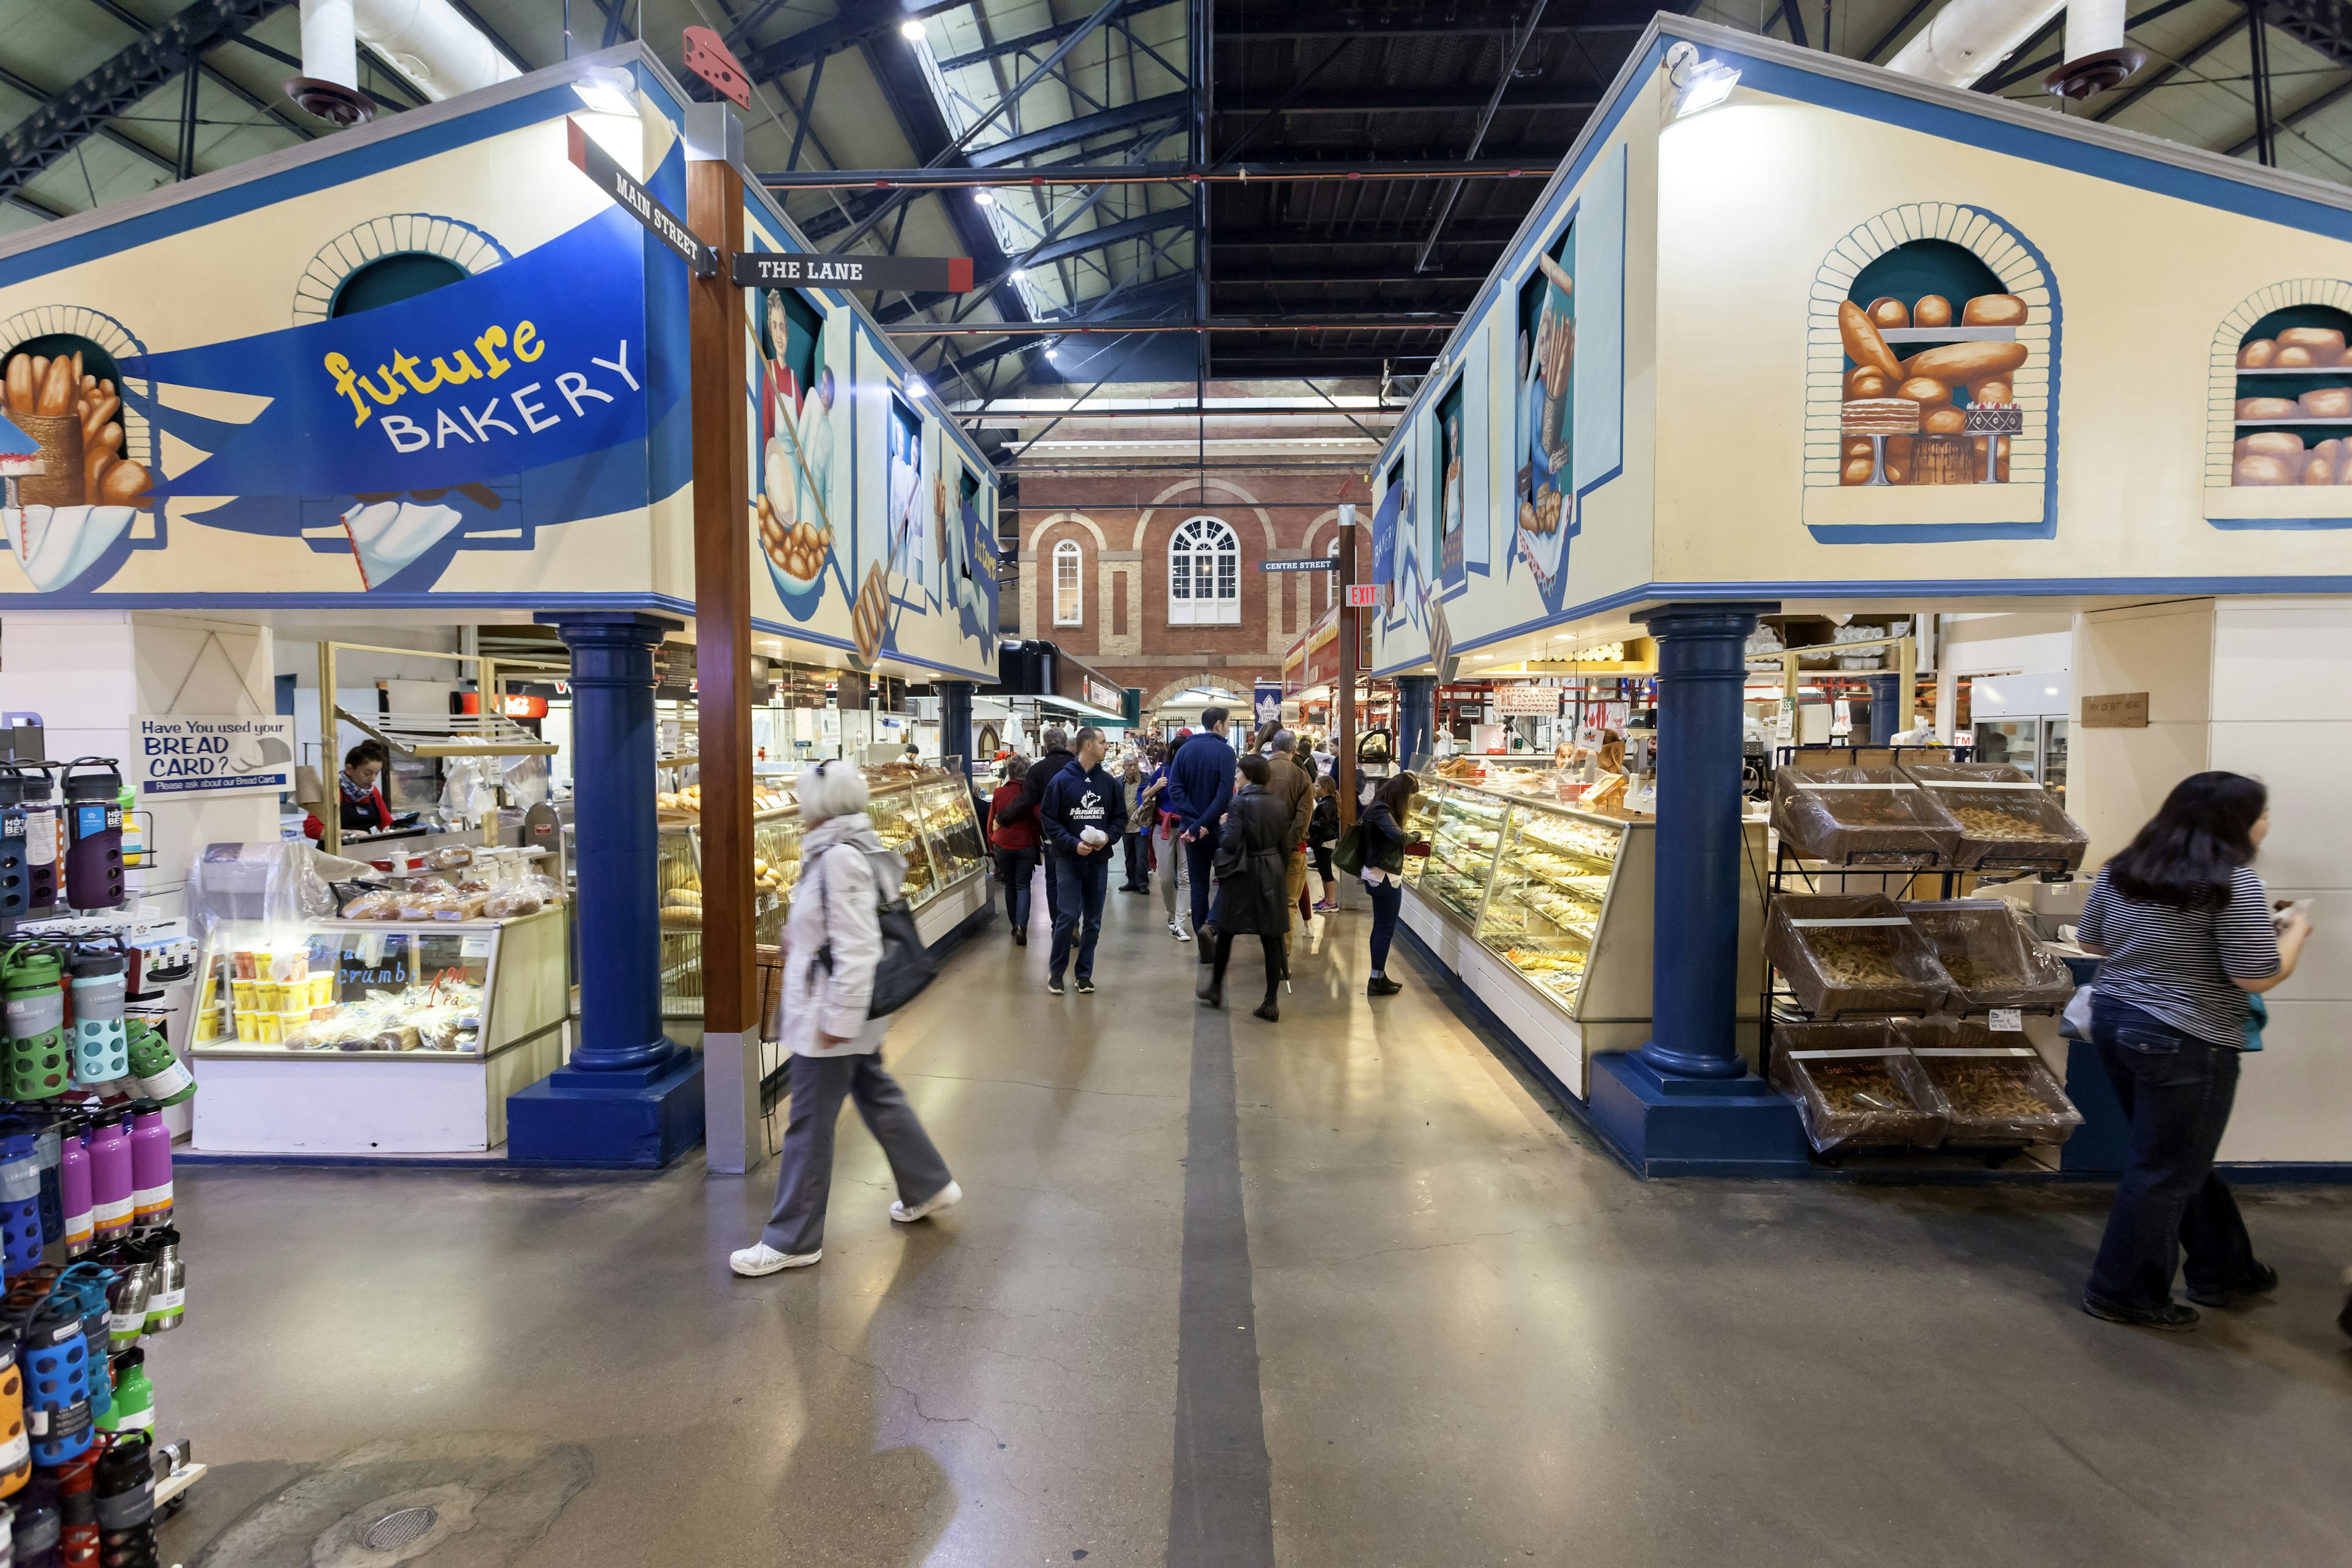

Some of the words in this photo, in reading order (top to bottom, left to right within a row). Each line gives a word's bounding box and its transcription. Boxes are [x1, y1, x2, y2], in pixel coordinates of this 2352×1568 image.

[616, 172, 651, 220] MAIN
[654, 208, 698, 261] STREET
[758, 261, 801, 278] THE
[807, 263, 862, 281] LANE
[324, 320, 545, 429] future
[379, 339, 641, 453] BAKERY
[974, 522, 997, 581] future
[1374, 523, 1396, 568] BAKERY
[1299, 560, 1331, 569] STREET
[1351, 586, 1376, 605] EXIT
[2101, 702, 2122, 711] DEBIT
[2125, 701, 2142, 709] HERE
[141, 721, 181, 734] Have
[186, 721, 214, 733] You
[217, 721, 251, 733] used
[254, 723, 285, 736] your
[143, 736, 229, 755] BREAD
[1954, 736, 1970, 745] TM
[156, 781, 183, 790] Please
[184, 780, 199, 789] ask
[200, 778, 222, 788] about
[236, 776, 257, 785] Bread
[258, 775, 276, 784] Card.
[1069, 807, 1105, 816] HUSKIES
[292, 935, 367, 962] Bread
[336, 962, 418, 984] crumbs
[1823, 1065, 1854, 1074] Garlic
[1959, 1066, 1996, 1076] Fennel
